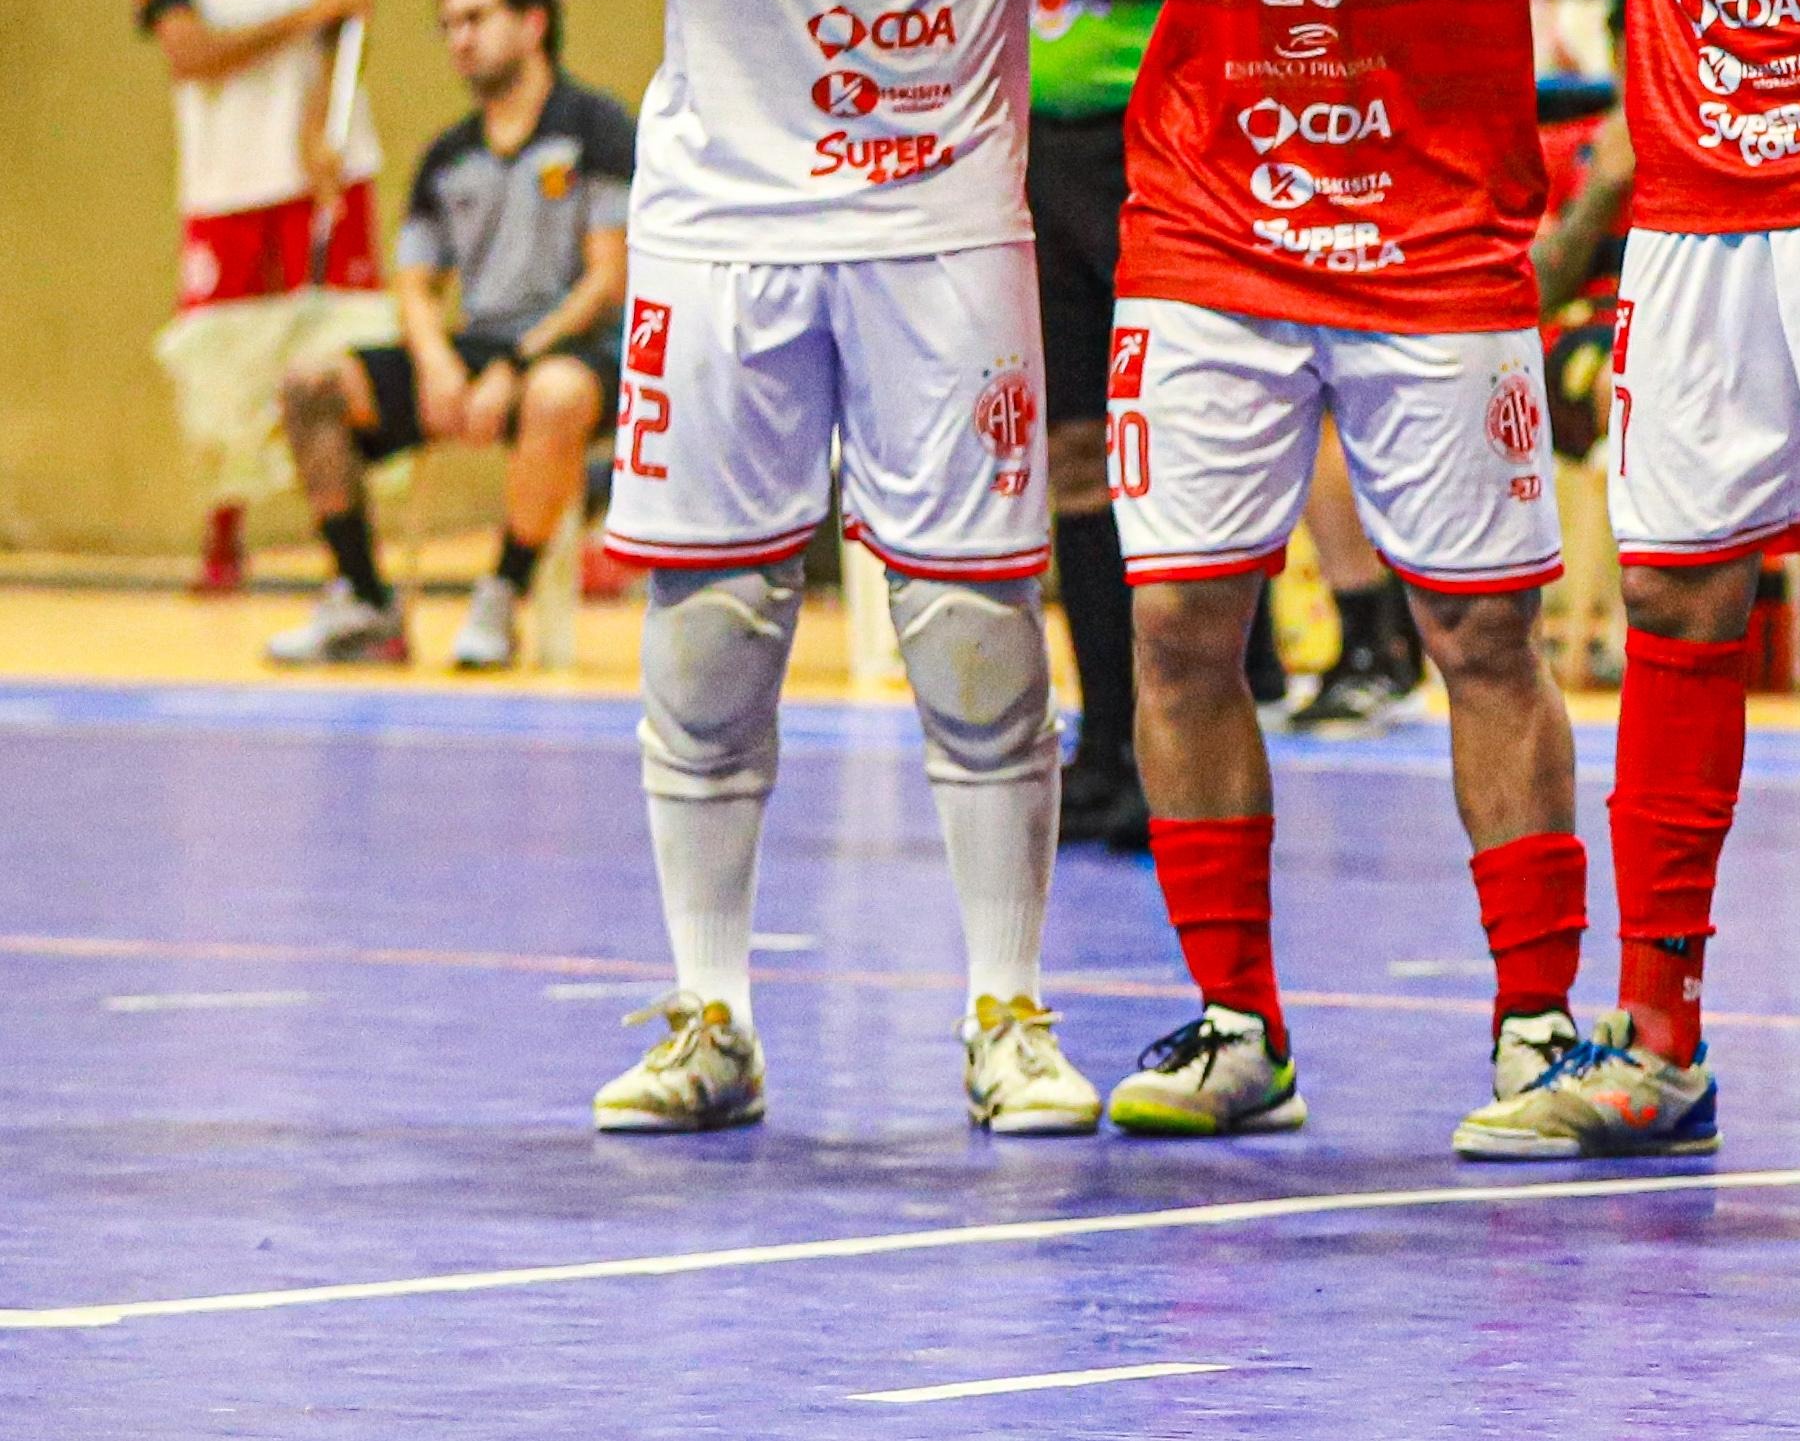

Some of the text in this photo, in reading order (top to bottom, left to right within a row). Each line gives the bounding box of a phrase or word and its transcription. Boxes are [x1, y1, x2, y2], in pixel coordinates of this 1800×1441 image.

[871, 6, 957, 50] CDA
[1299, 98, 1393, 145] CDA
[810, 130, 938, 177] SUPER
[1252, 216, 1382, 255] SUPER
